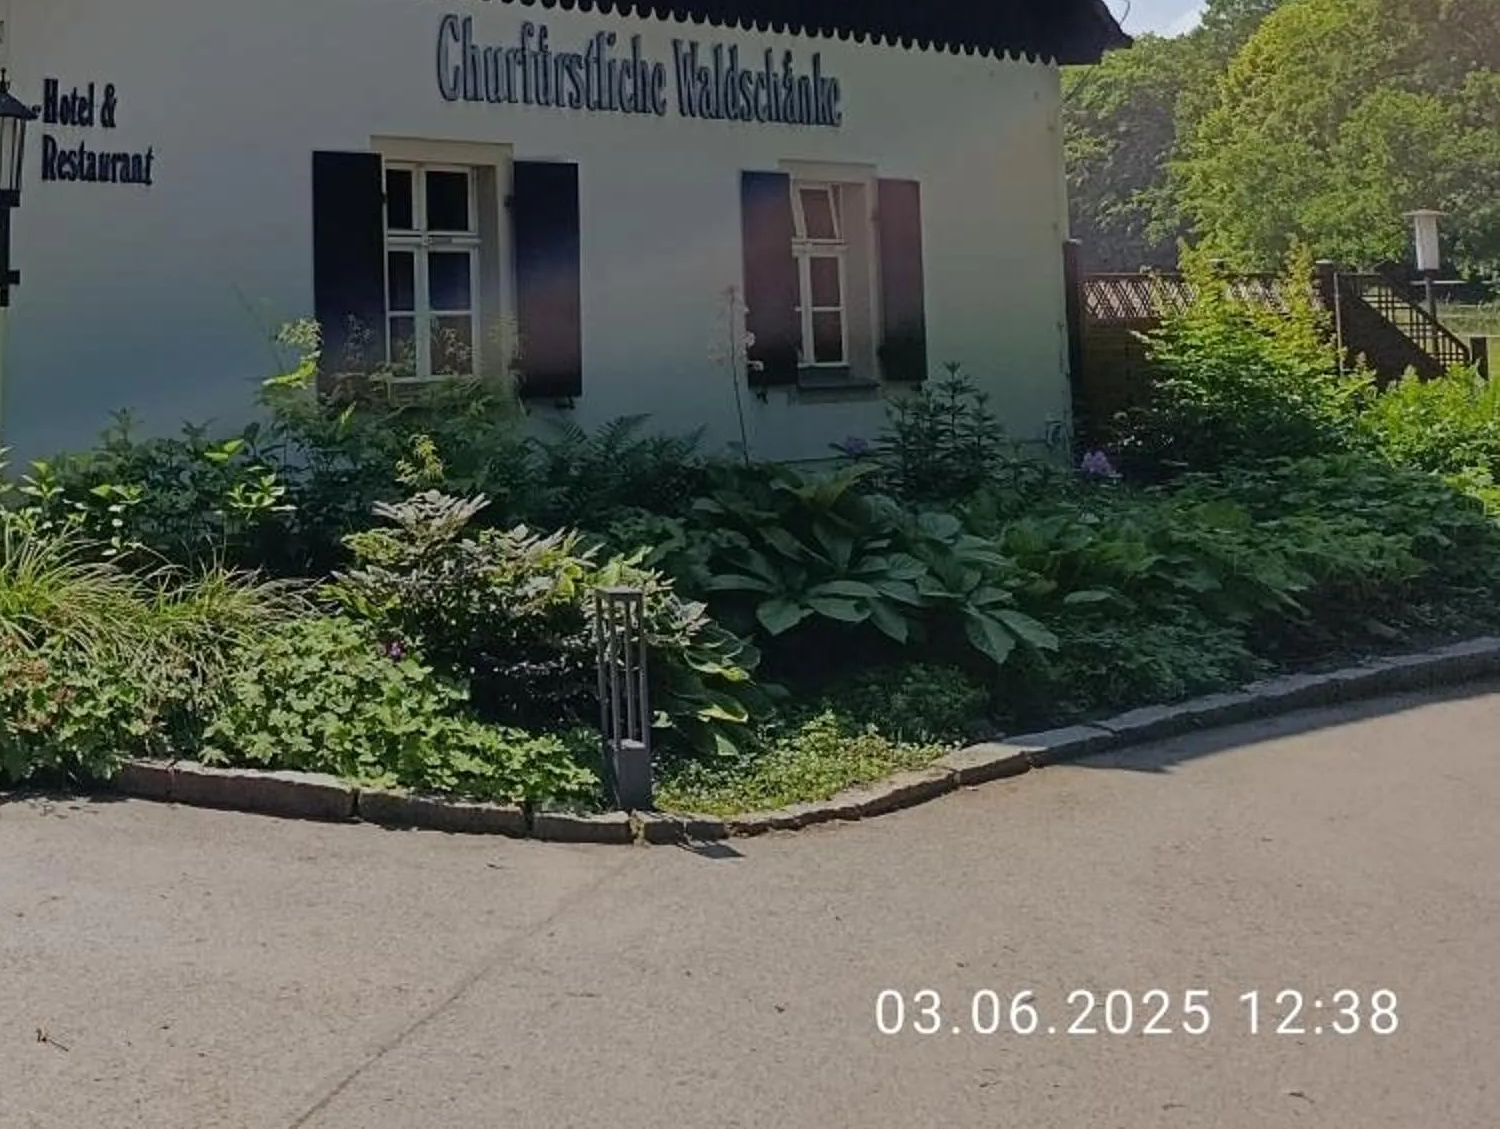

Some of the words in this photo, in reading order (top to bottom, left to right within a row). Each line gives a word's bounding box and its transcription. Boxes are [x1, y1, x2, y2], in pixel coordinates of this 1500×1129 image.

[43, 78, 95, 127] Hotel
[100, 83, 117, 128] &
[41, 134, 154, 186] Restaurant
